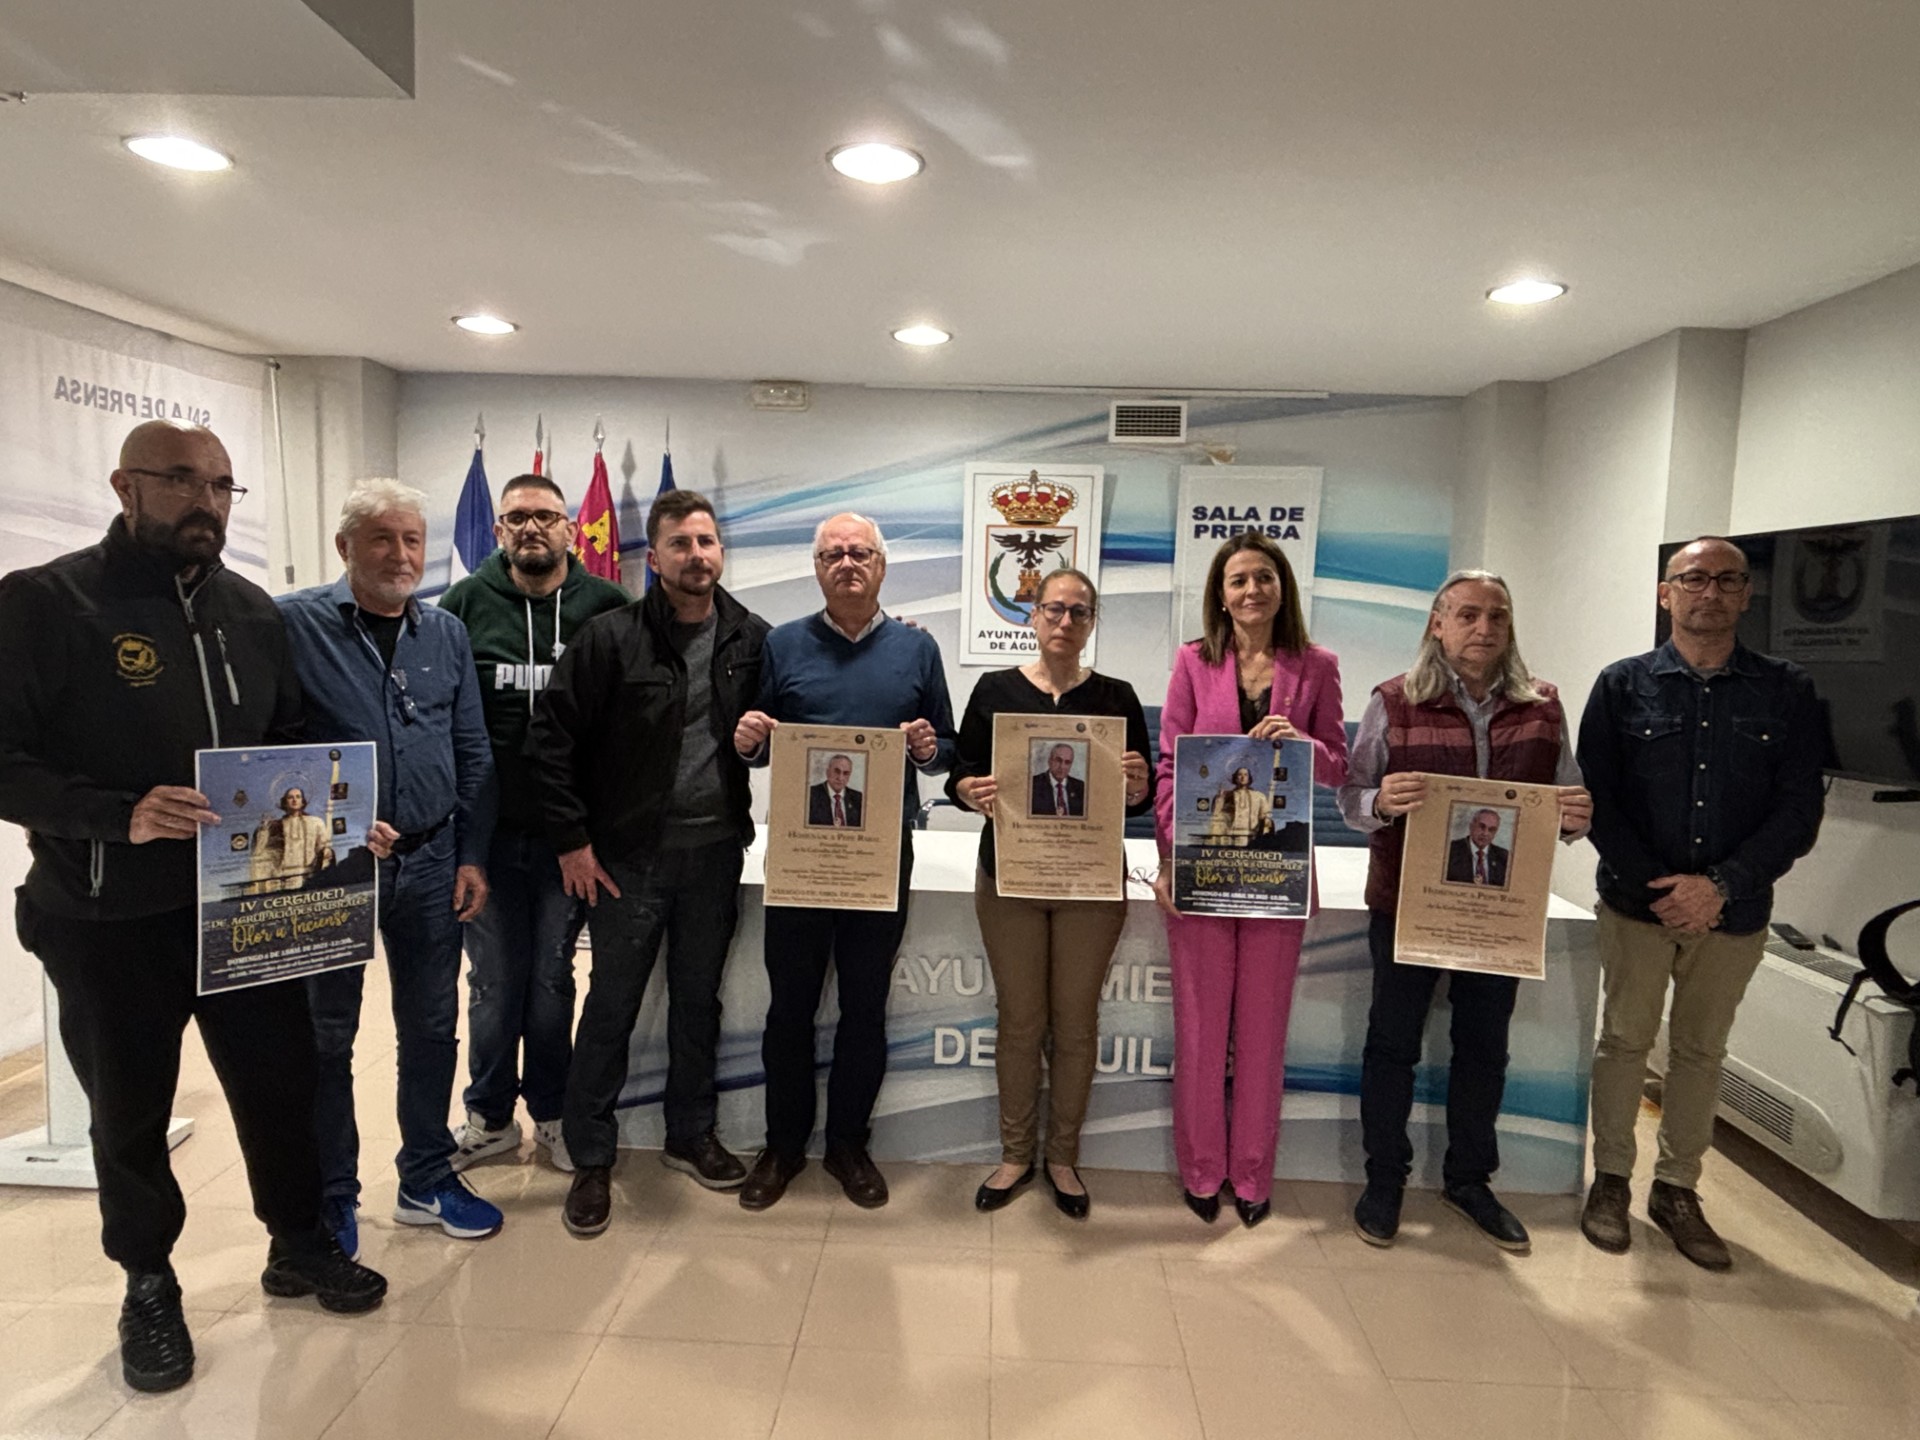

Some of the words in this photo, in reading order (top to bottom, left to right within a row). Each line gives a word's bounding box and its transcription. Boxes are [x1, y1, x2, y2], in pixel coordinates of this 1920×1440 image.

[1192, 505, 1262, 521] SALA
[1270, 507, 1305, 521] DE
[1194, 524, 1301, 540] PRENSA
[977, 630, 1037, 639] AYUNTAM
[990, 641, 1006, 650] DE
[1201, 849, 1213, 858] IV
[1218, 850, 1283, 861] CERTAMEN
[240, 902, 257, 913] IV
[264, 887, 346, 909] CERTAMEN
[212, 920, 227, 928] DE
[232, 923, 272, 953] Olor
[934, 1027, 998, 1067] DE
